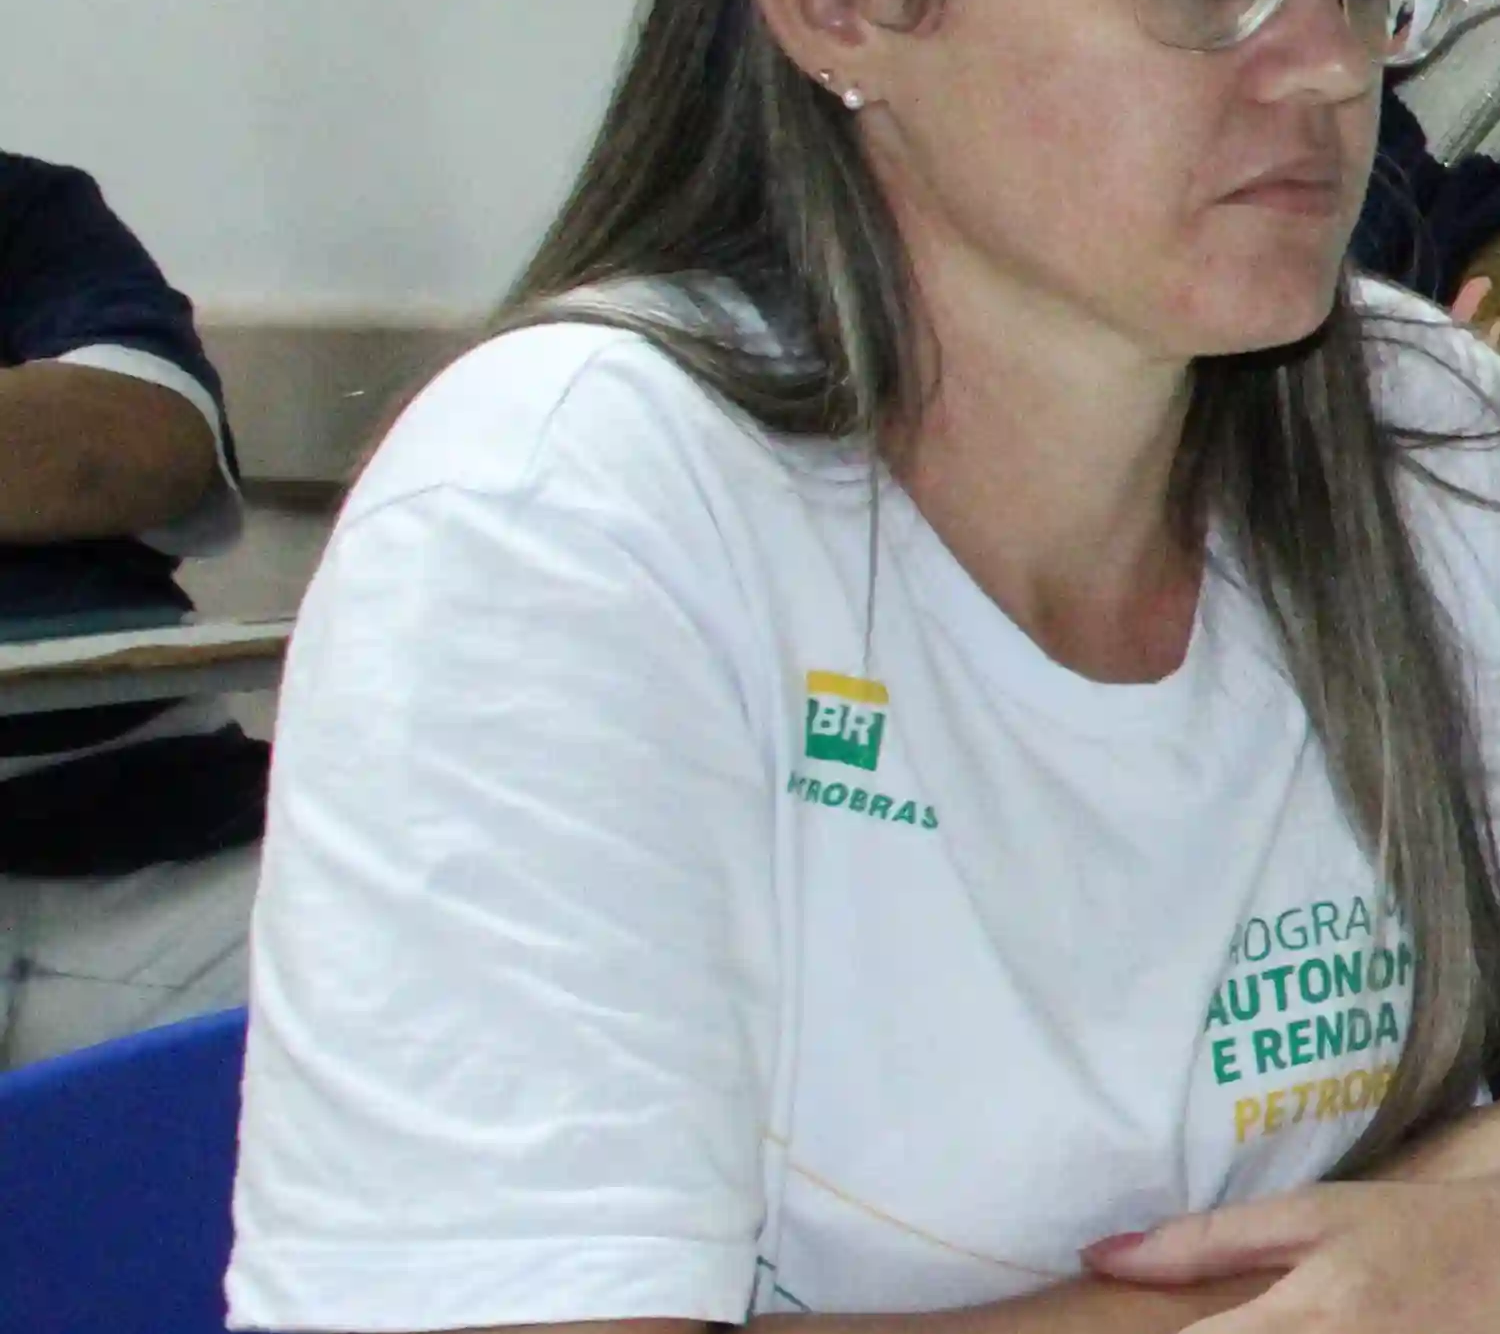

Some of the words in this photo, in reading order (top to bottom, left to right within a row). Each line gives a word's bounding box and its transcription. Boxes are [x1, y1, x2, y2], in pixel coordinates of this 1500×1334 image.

[811, 696, 877, 746] BR
[1212, 1037, 1242, 1086] E
[1252, 1002, 1399, 1075] RENDA
